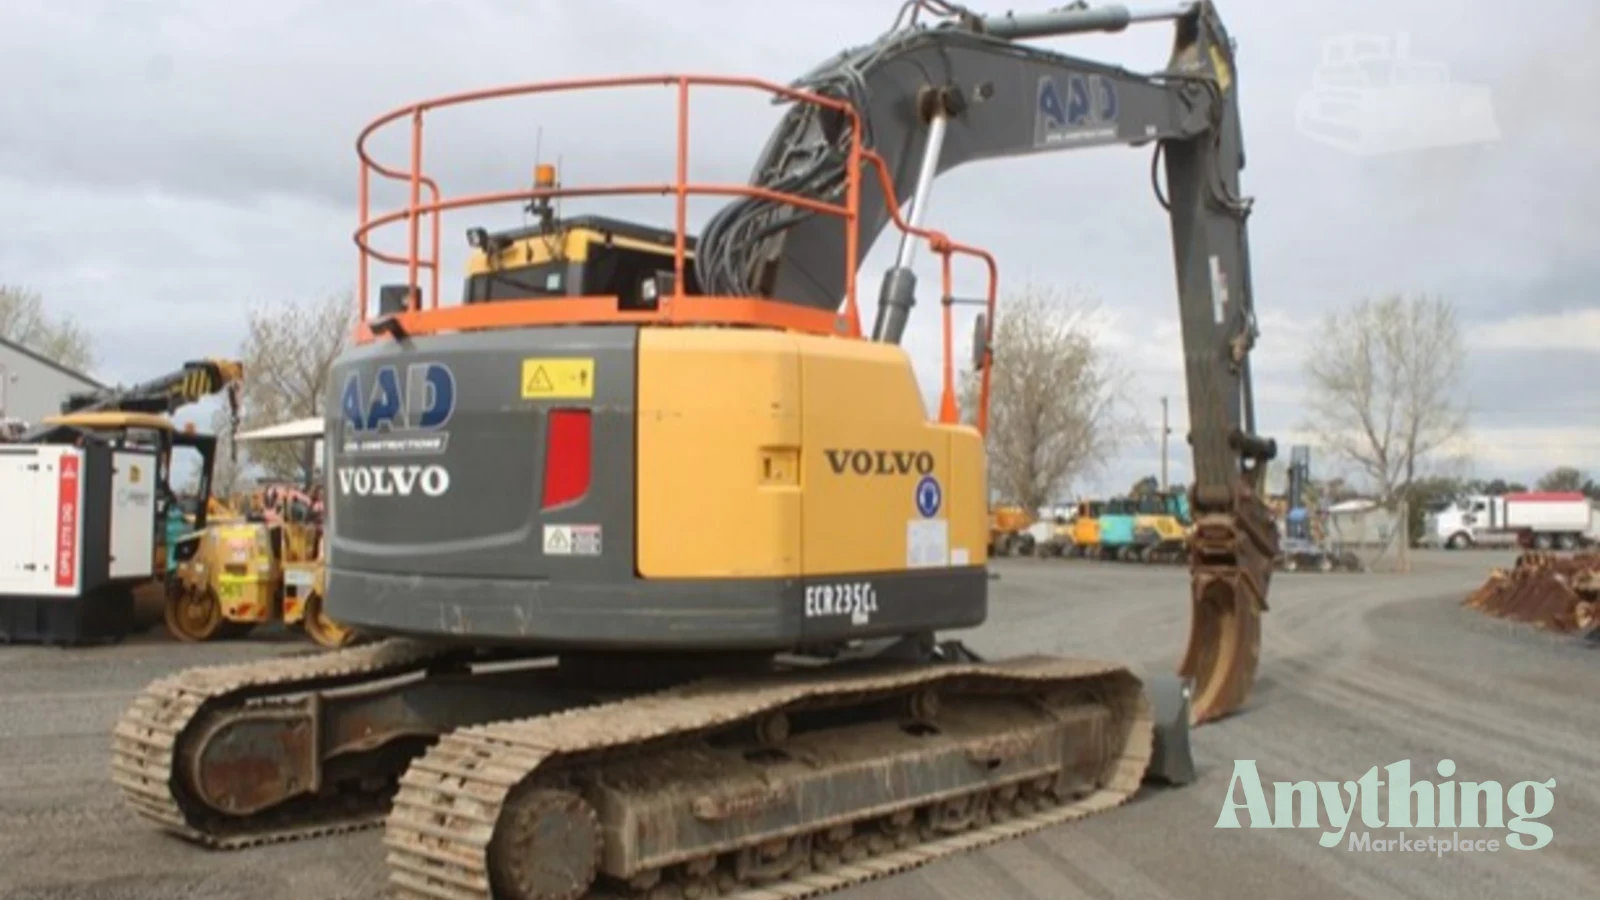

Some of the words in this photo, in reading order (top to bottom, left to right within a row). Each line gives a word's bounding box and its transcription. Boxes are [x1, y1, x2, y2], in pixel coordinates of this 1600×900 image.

[1038, 74, 1119, 126] AAD
[341, 363, 457, 432] AAD
[338, 464, 450, 496] VOLVO
[823, 449, 935, 475] VOLVO
